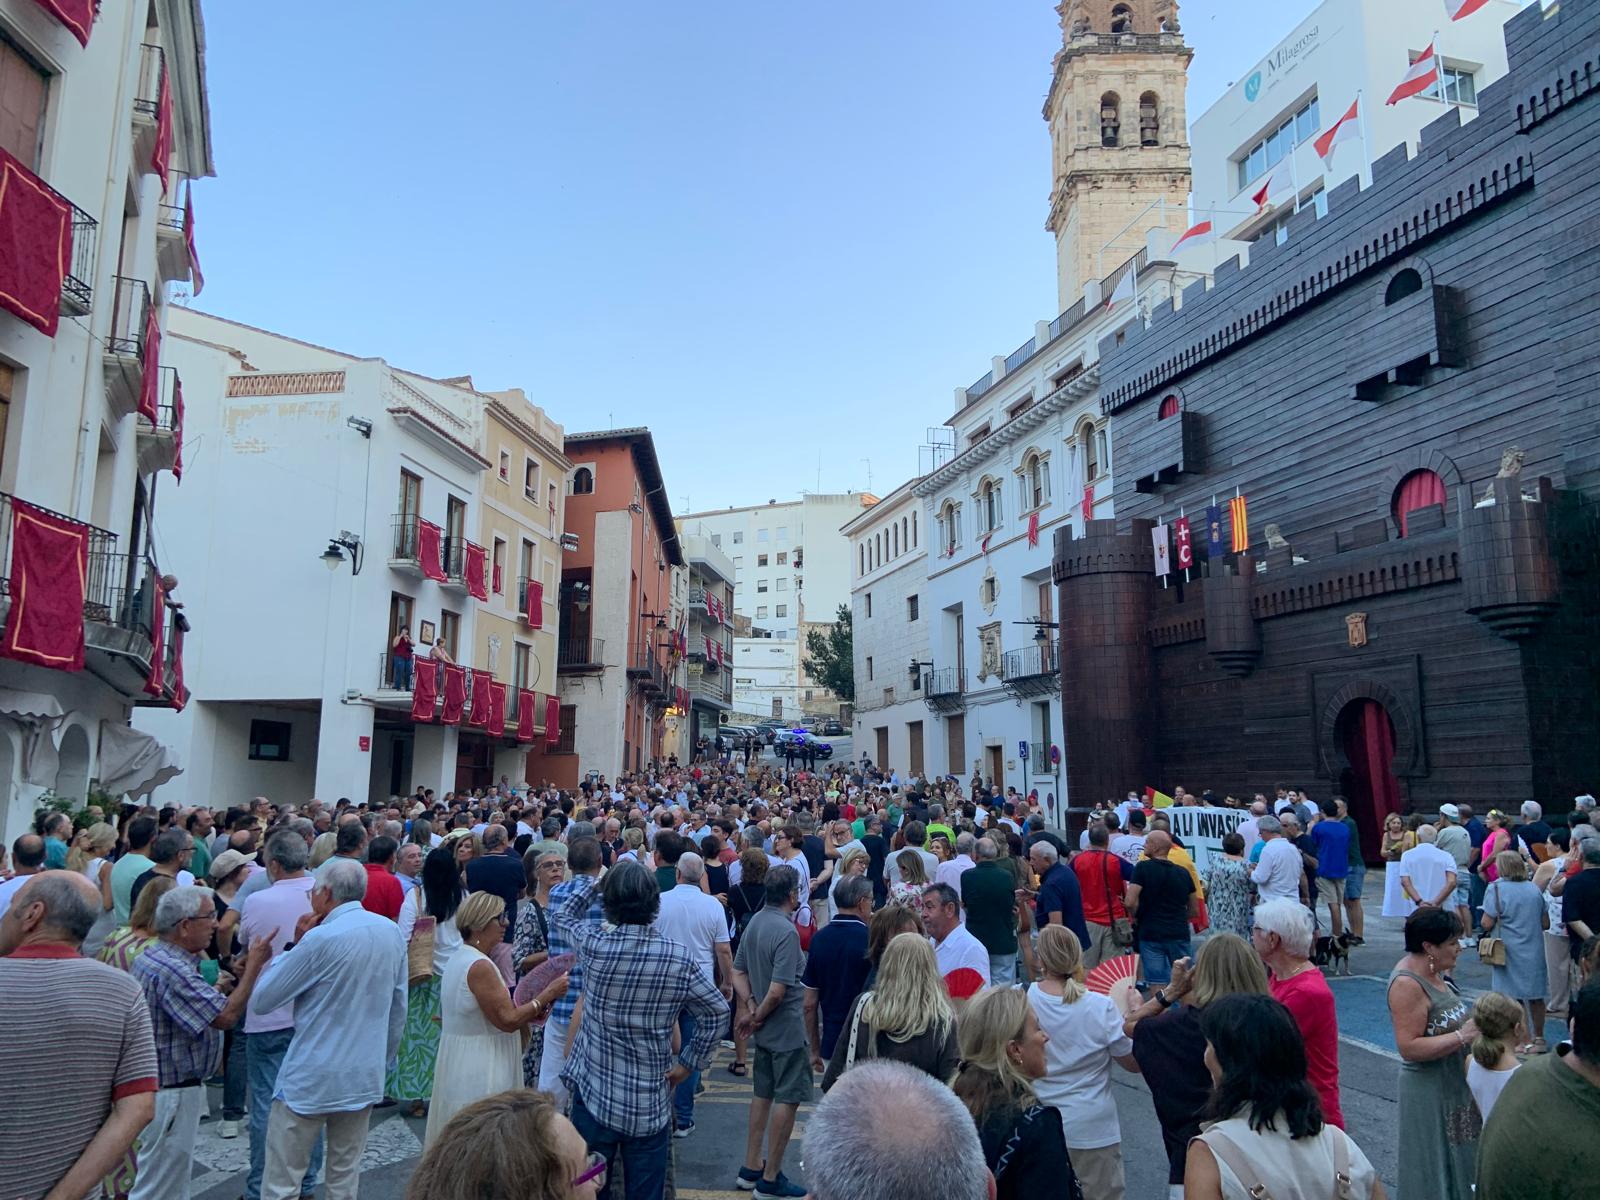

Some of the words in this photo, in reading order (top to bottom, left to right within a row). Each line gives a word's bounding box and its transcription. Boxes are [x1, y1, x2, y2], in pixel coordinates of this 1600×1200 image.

[1267, 25, 1319, 77] Milagrosa
[1173, 813, 1181, 836] A
[1197, 812, 1249, 839] INVASIÓ
